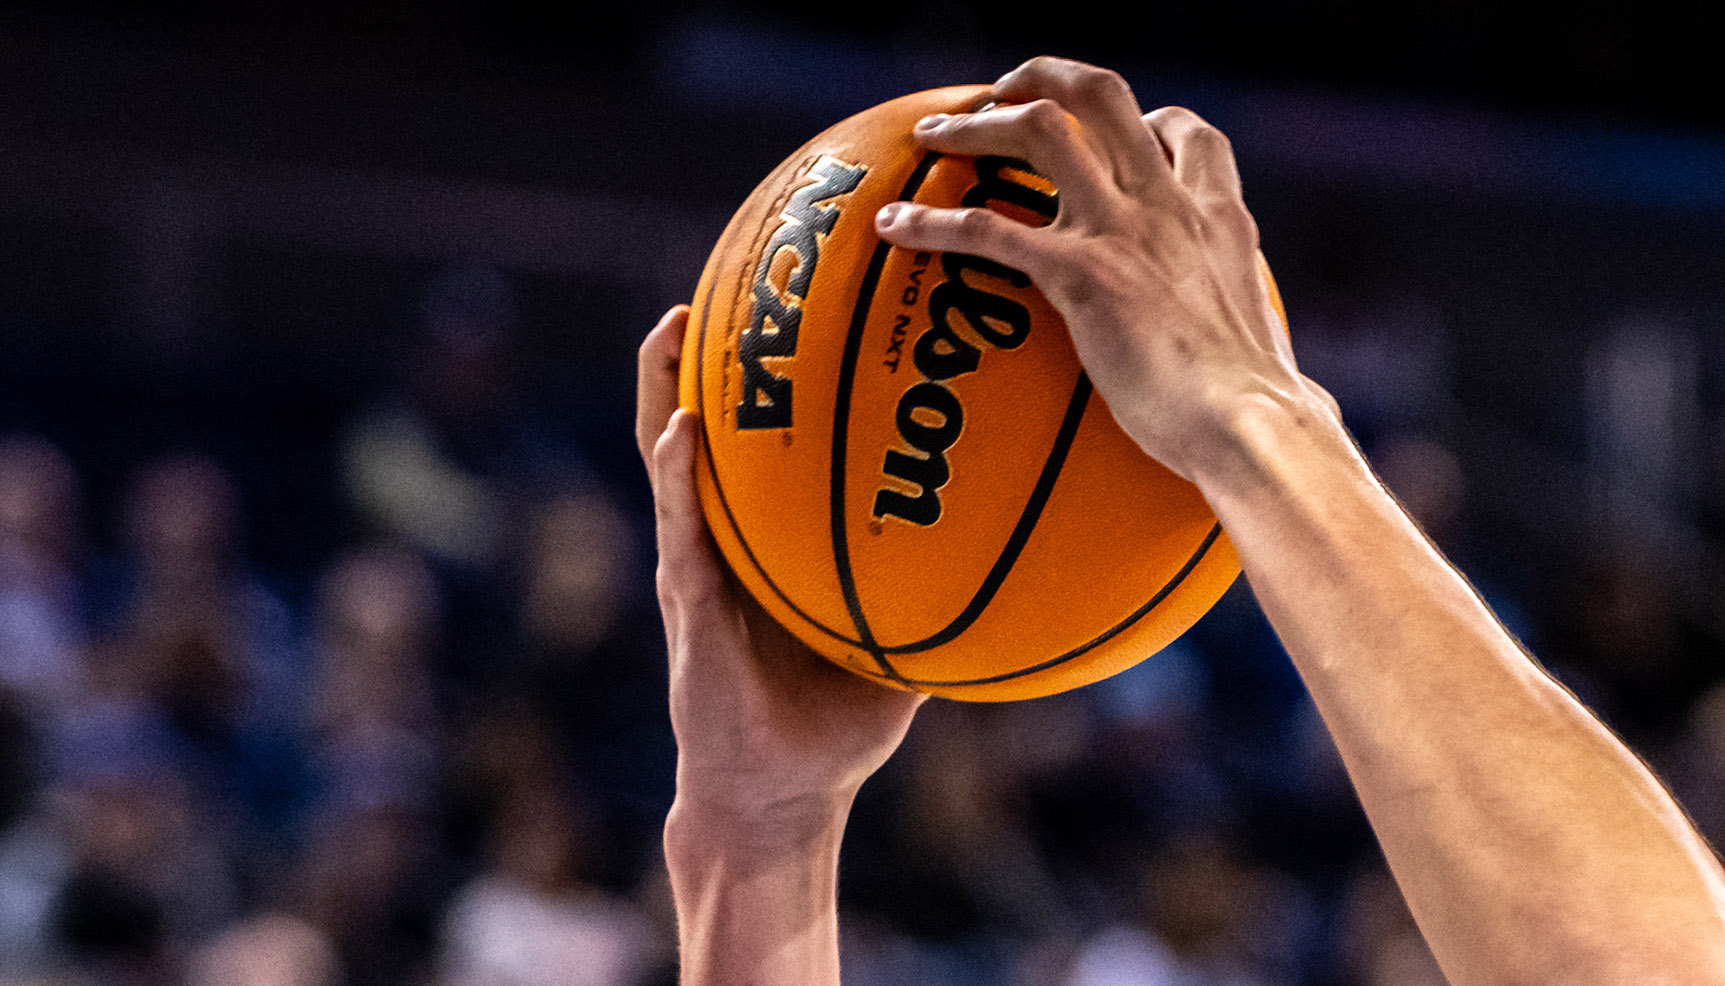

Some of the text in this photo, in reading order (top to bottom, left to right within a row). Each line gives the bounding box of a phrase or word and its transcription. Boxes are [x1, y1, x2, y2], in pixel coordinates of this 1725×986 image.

[736, 153, 869, 430] NCAA
[882, 250, 933, 375] EVO NXT
